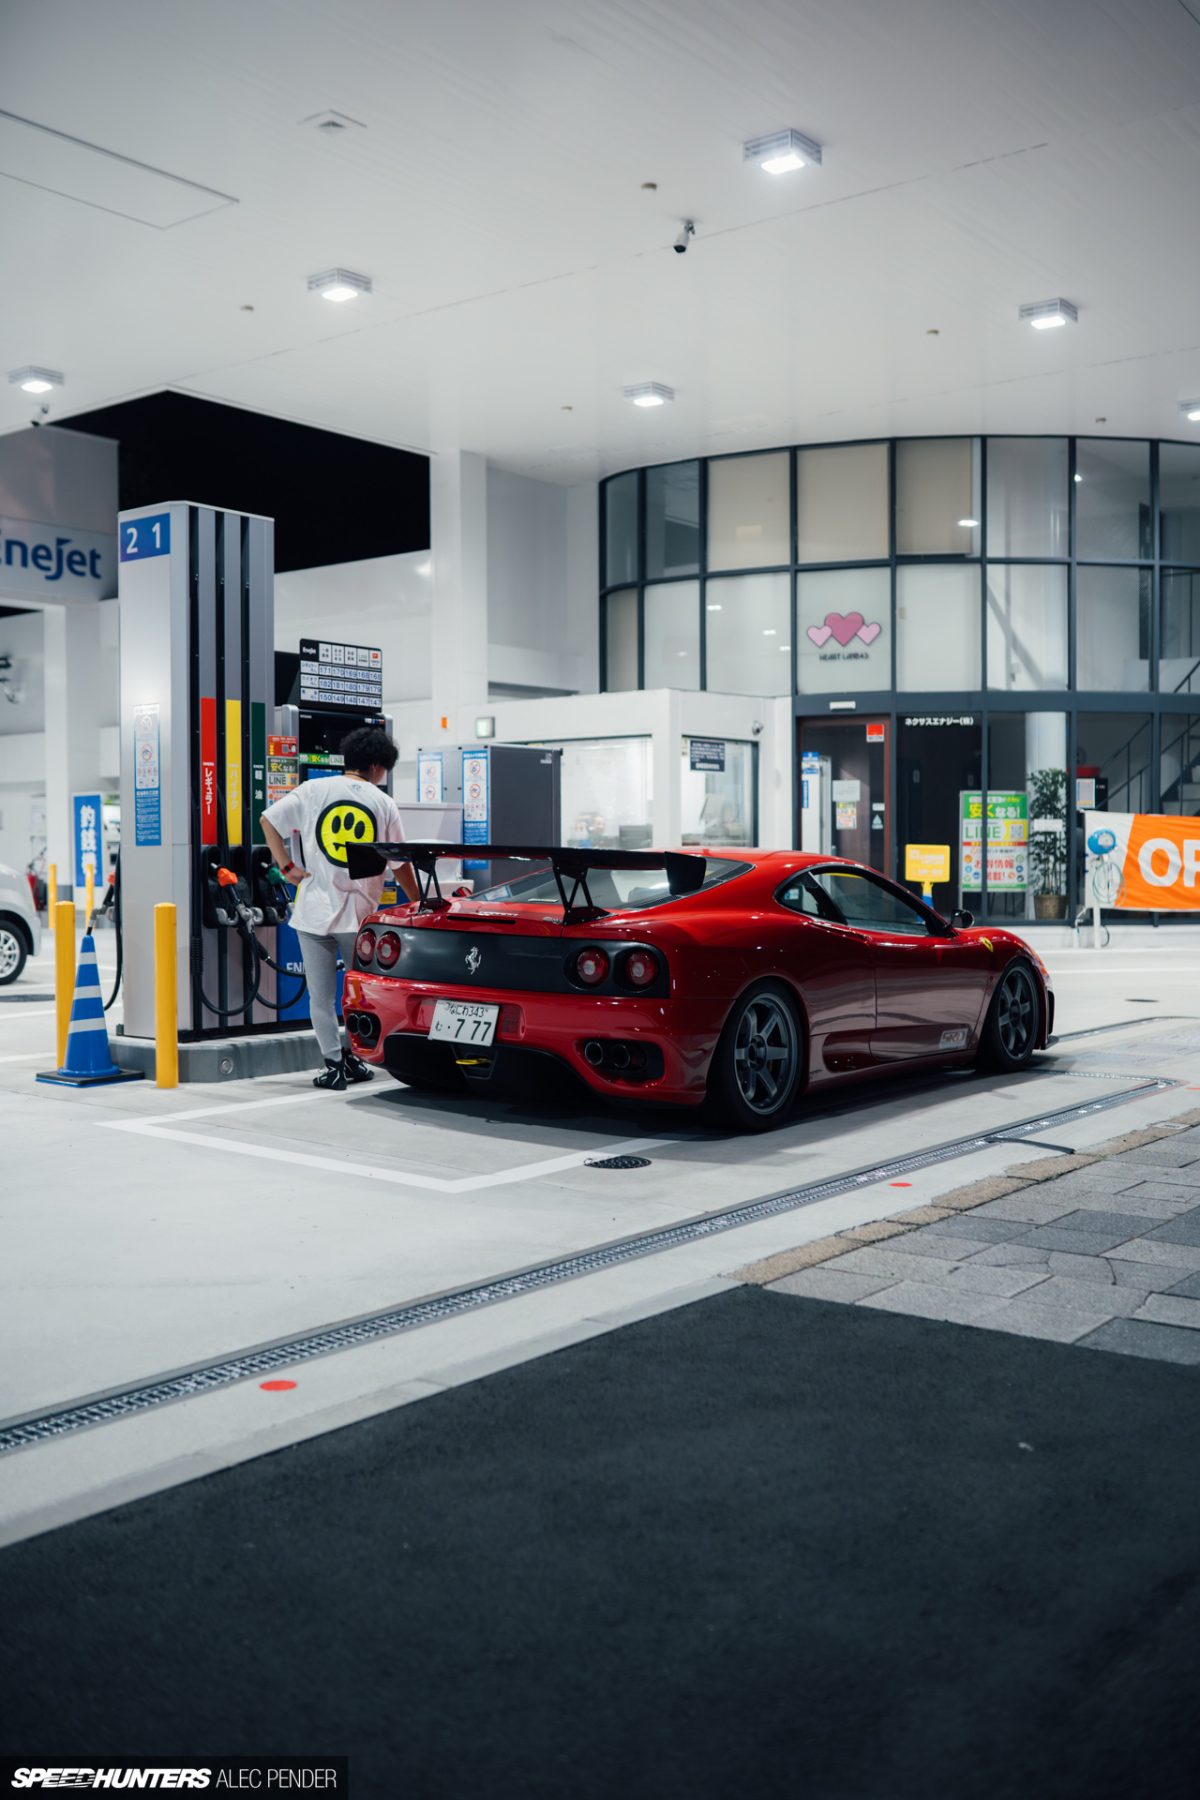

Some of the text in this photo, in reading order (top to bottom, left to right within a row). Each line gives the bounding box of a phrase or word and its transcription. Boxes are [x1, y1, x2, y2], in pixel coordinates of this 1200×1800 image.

[0, 528, 102, 580] neJet
[126, 522, 161, 554] 2 1
[204, 767, 213, 815] レギュラー
[230, 769, 238, 810] ハイオク
[269, 776, 286, 785] LINE
[966, 826, 1001, 839] LINE
